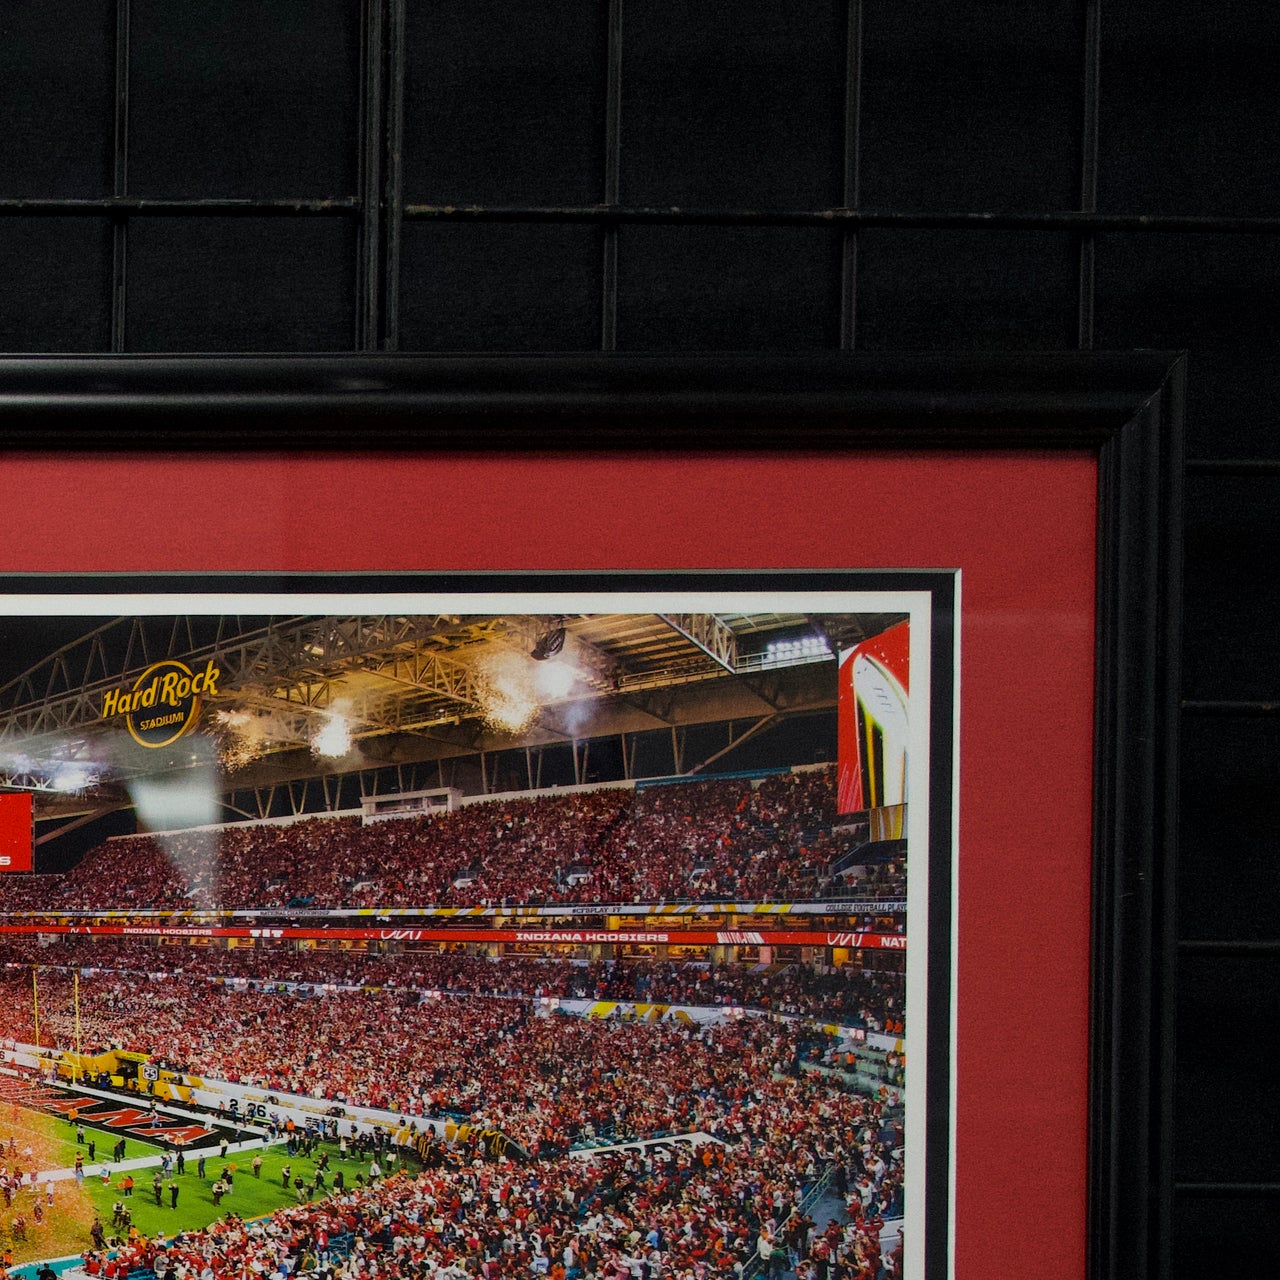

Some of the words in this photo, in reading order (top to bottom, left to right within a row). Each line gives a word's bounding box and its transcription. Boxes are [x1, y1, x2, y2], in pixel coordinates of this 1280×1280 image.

[102, 675, 158, 718] Hard
[160, 659, 220, 707] Rock
[140, 712, 185, 731] STADIUM
[162, 928, 212, 936] HOOSIERS
[515, 932, 582, 942] INDIANA
[585, 932, 669, 942] HOOSIERS
